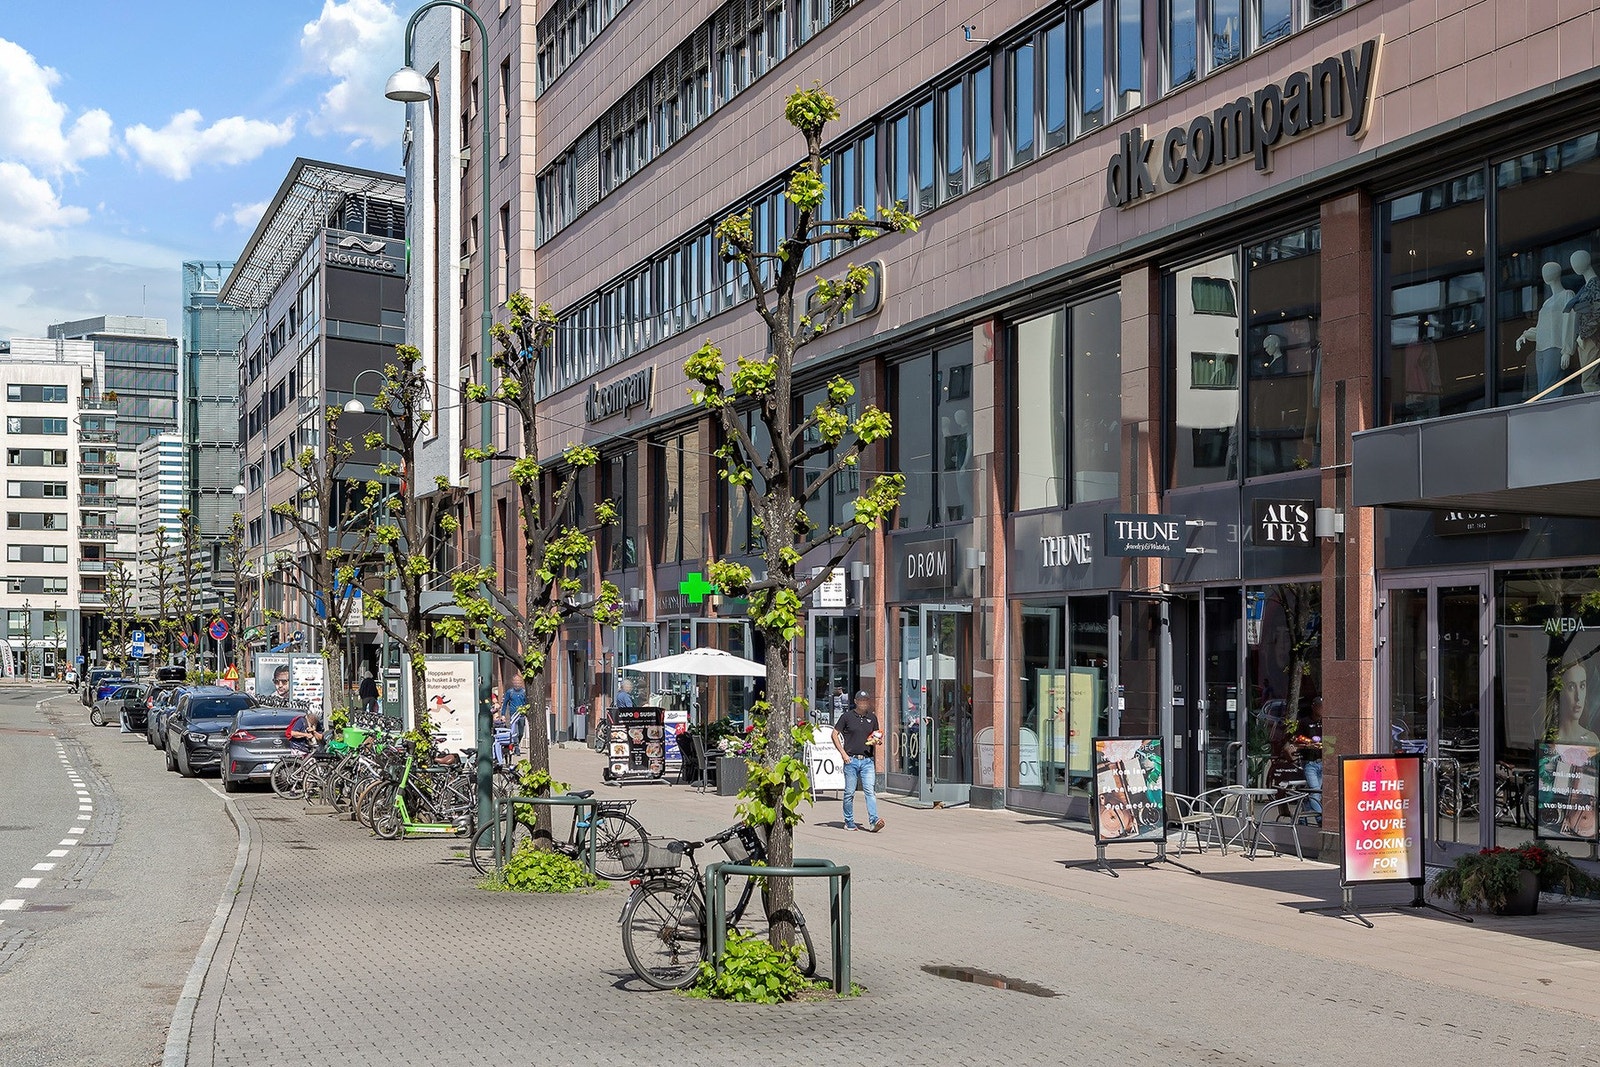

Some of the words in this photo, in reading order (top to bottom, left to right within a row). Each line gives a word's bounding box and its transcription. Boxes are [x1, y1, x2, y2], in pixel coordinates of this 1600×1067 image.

[1107, 127, 1156, 208] dk
[1163, 38, 1377, 184] company
[328, 252, 394, 272] NOVENCO
[585, 383, 599, 423] dk
[599, 366, 653, 418] company
[1262, 504, 1309, 523] AUS
[1114, 520, 1180, 541] THUNE
[1262, 523, 1309, 542] TER
[1040, 532, 1092, 567] THUNE
[908, 550, 947, 579] DRØM
[1544, 617, 1585, 632] AVEDA
[135, 632, 142, 641] P
[892, 732, 931, 760] DRØ
[1361, 781, 1377, 792] BE
[1380, 779, 1405, 792] THE
[1126, 801, 1143, 810] med
[1357, 798, 1410, 812] CHANGE
[1361, 818, 1407, 831] YOU'RE
[1355, 836, 1413, 851] LOOKING
[1373, 857, 1399, 869] FOR
